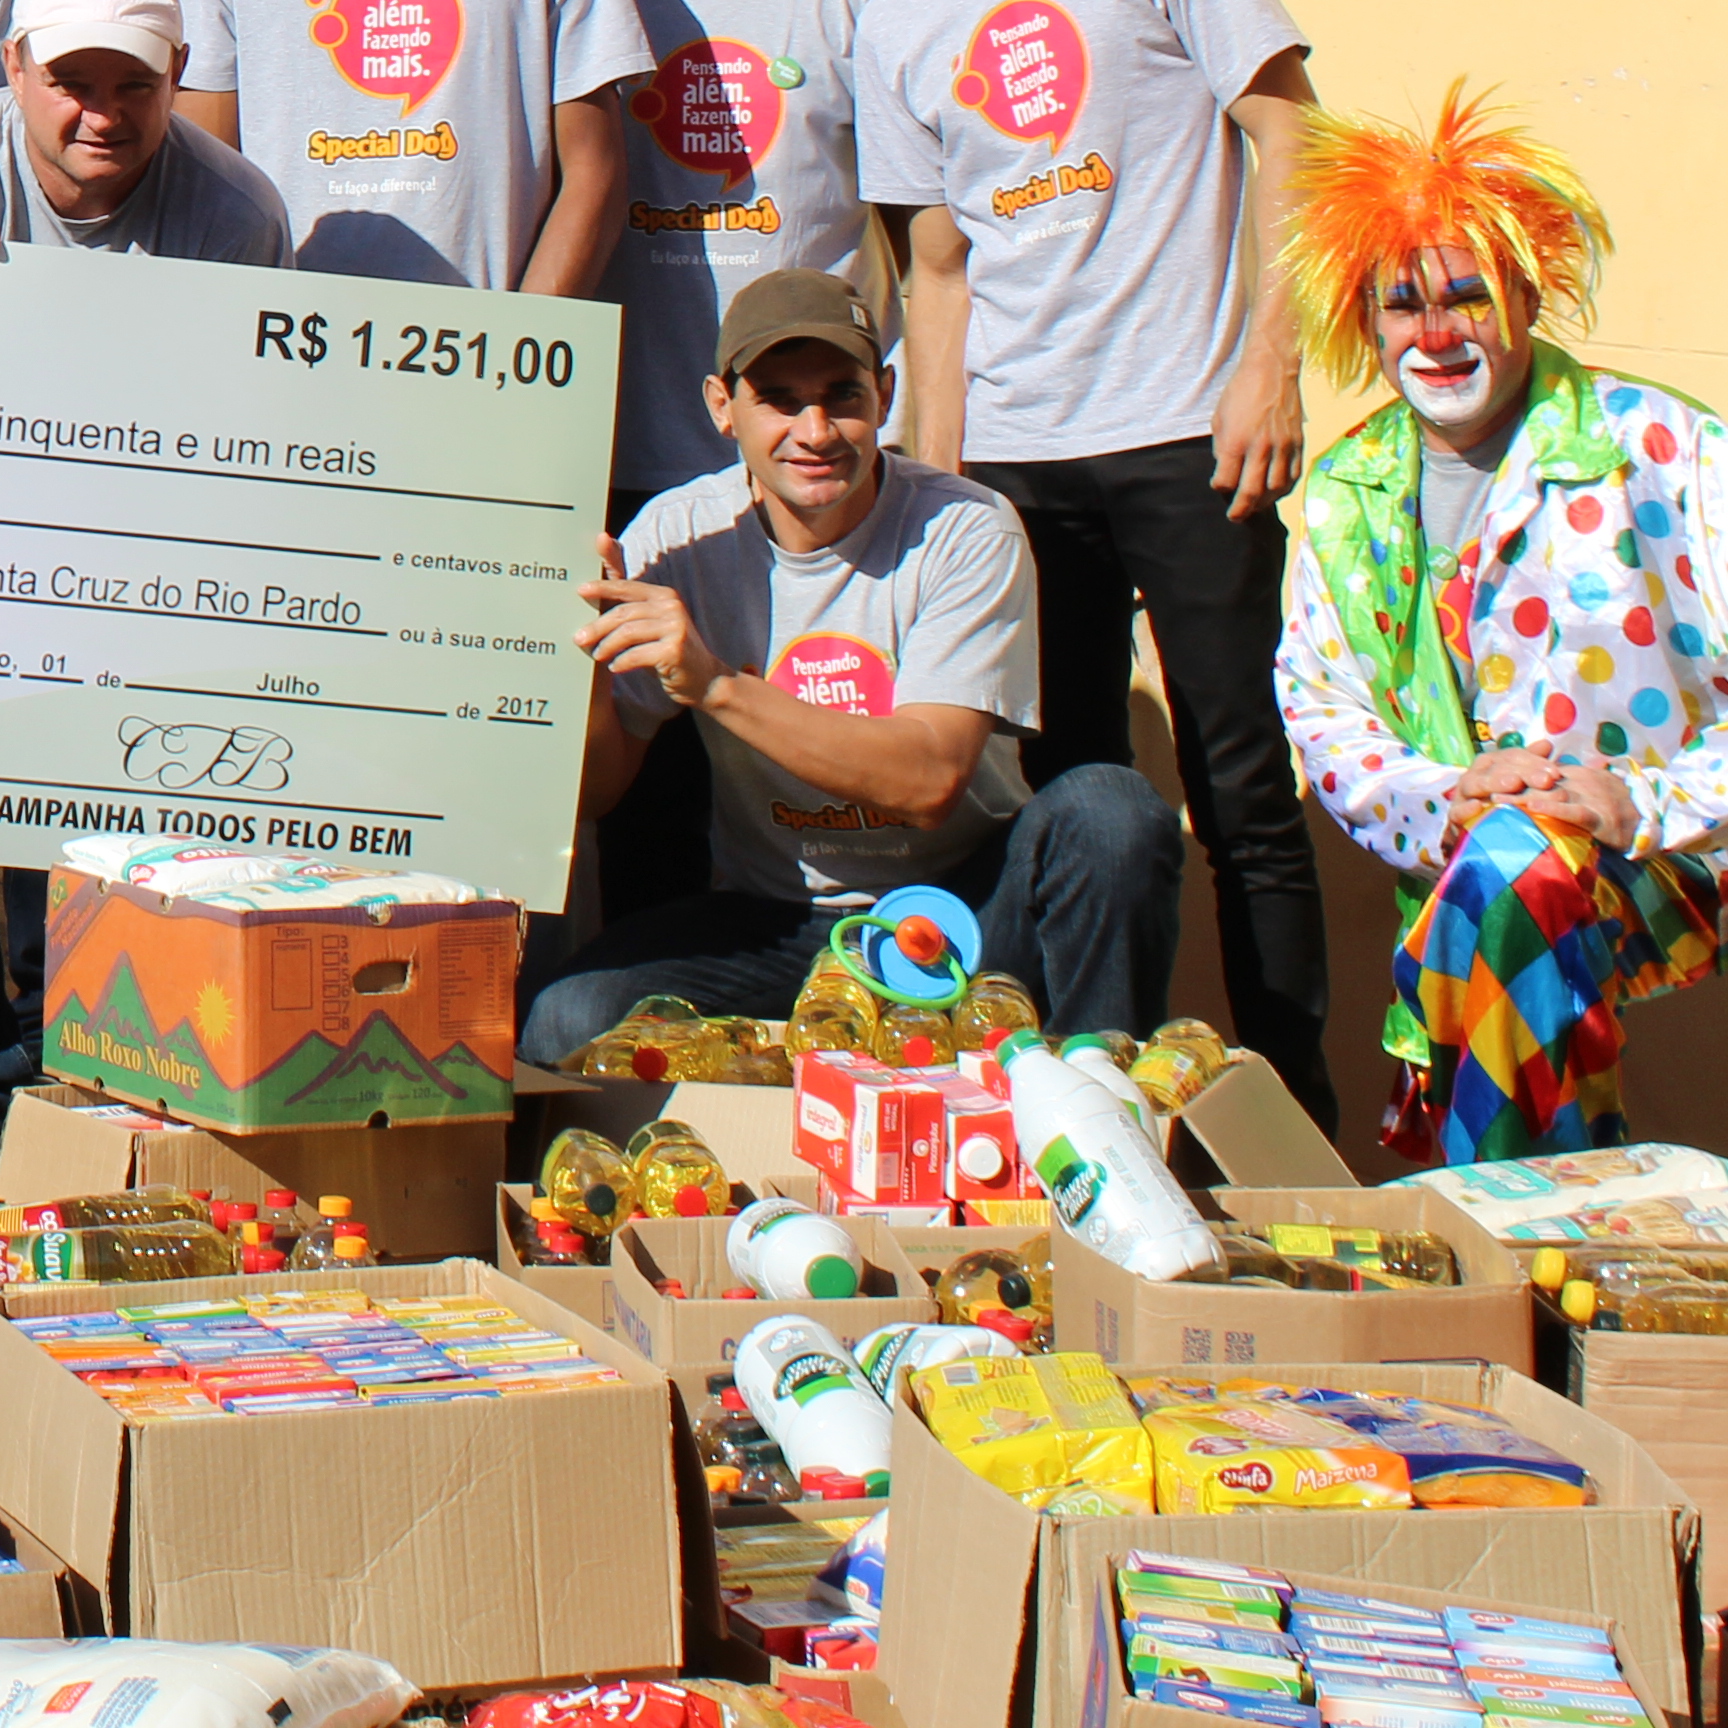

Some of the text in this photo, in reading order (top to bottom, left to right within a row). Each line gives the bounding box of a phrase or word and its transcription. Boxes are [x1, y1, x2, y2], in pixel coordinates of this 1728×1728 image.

[363, 0, 431, 28] além.
[989, 13, 1049, 47] Pensando
[362, 27, 431, 50] Fazendo
[362, 48, 431, 79] mais.
[1000, 40, 1054, 76] além.
[1003, 62, 1059, 98] Fazendo
[1012, 85, 1066, 127] mais.
[254, 309, 575, 391] R$ 1.251,00
[175, 430, 199, 459] e
[213, 432, 271, 467] um
[286, 440, 378, 476] reais
[392, 550, 569, 582] e centavos acima
[49, 564, 130, 605] Cruz
[140, 571, 183, 610] do
[194, 577, 250, 618] Rio
[262, 583, 362, 627] Pardo
[399, 625, 557, 655] ou à sua ordem
[41, 652, 68, 674] 01
[95, 669, 122, 690] de
[256, 672, 321, 698] Julho
[455, 700, 481, 722] de
[495, 696, 549, 720] 2017
[156, 806, 257, 845] TODOS
[266, 816, 340, 852] PELO
[348, 825, 413, 858] BEM
[58, 1020, 201, 1088] Alho Roxo Nobre
[1294, 1462, 1379, 1496] Maizena
